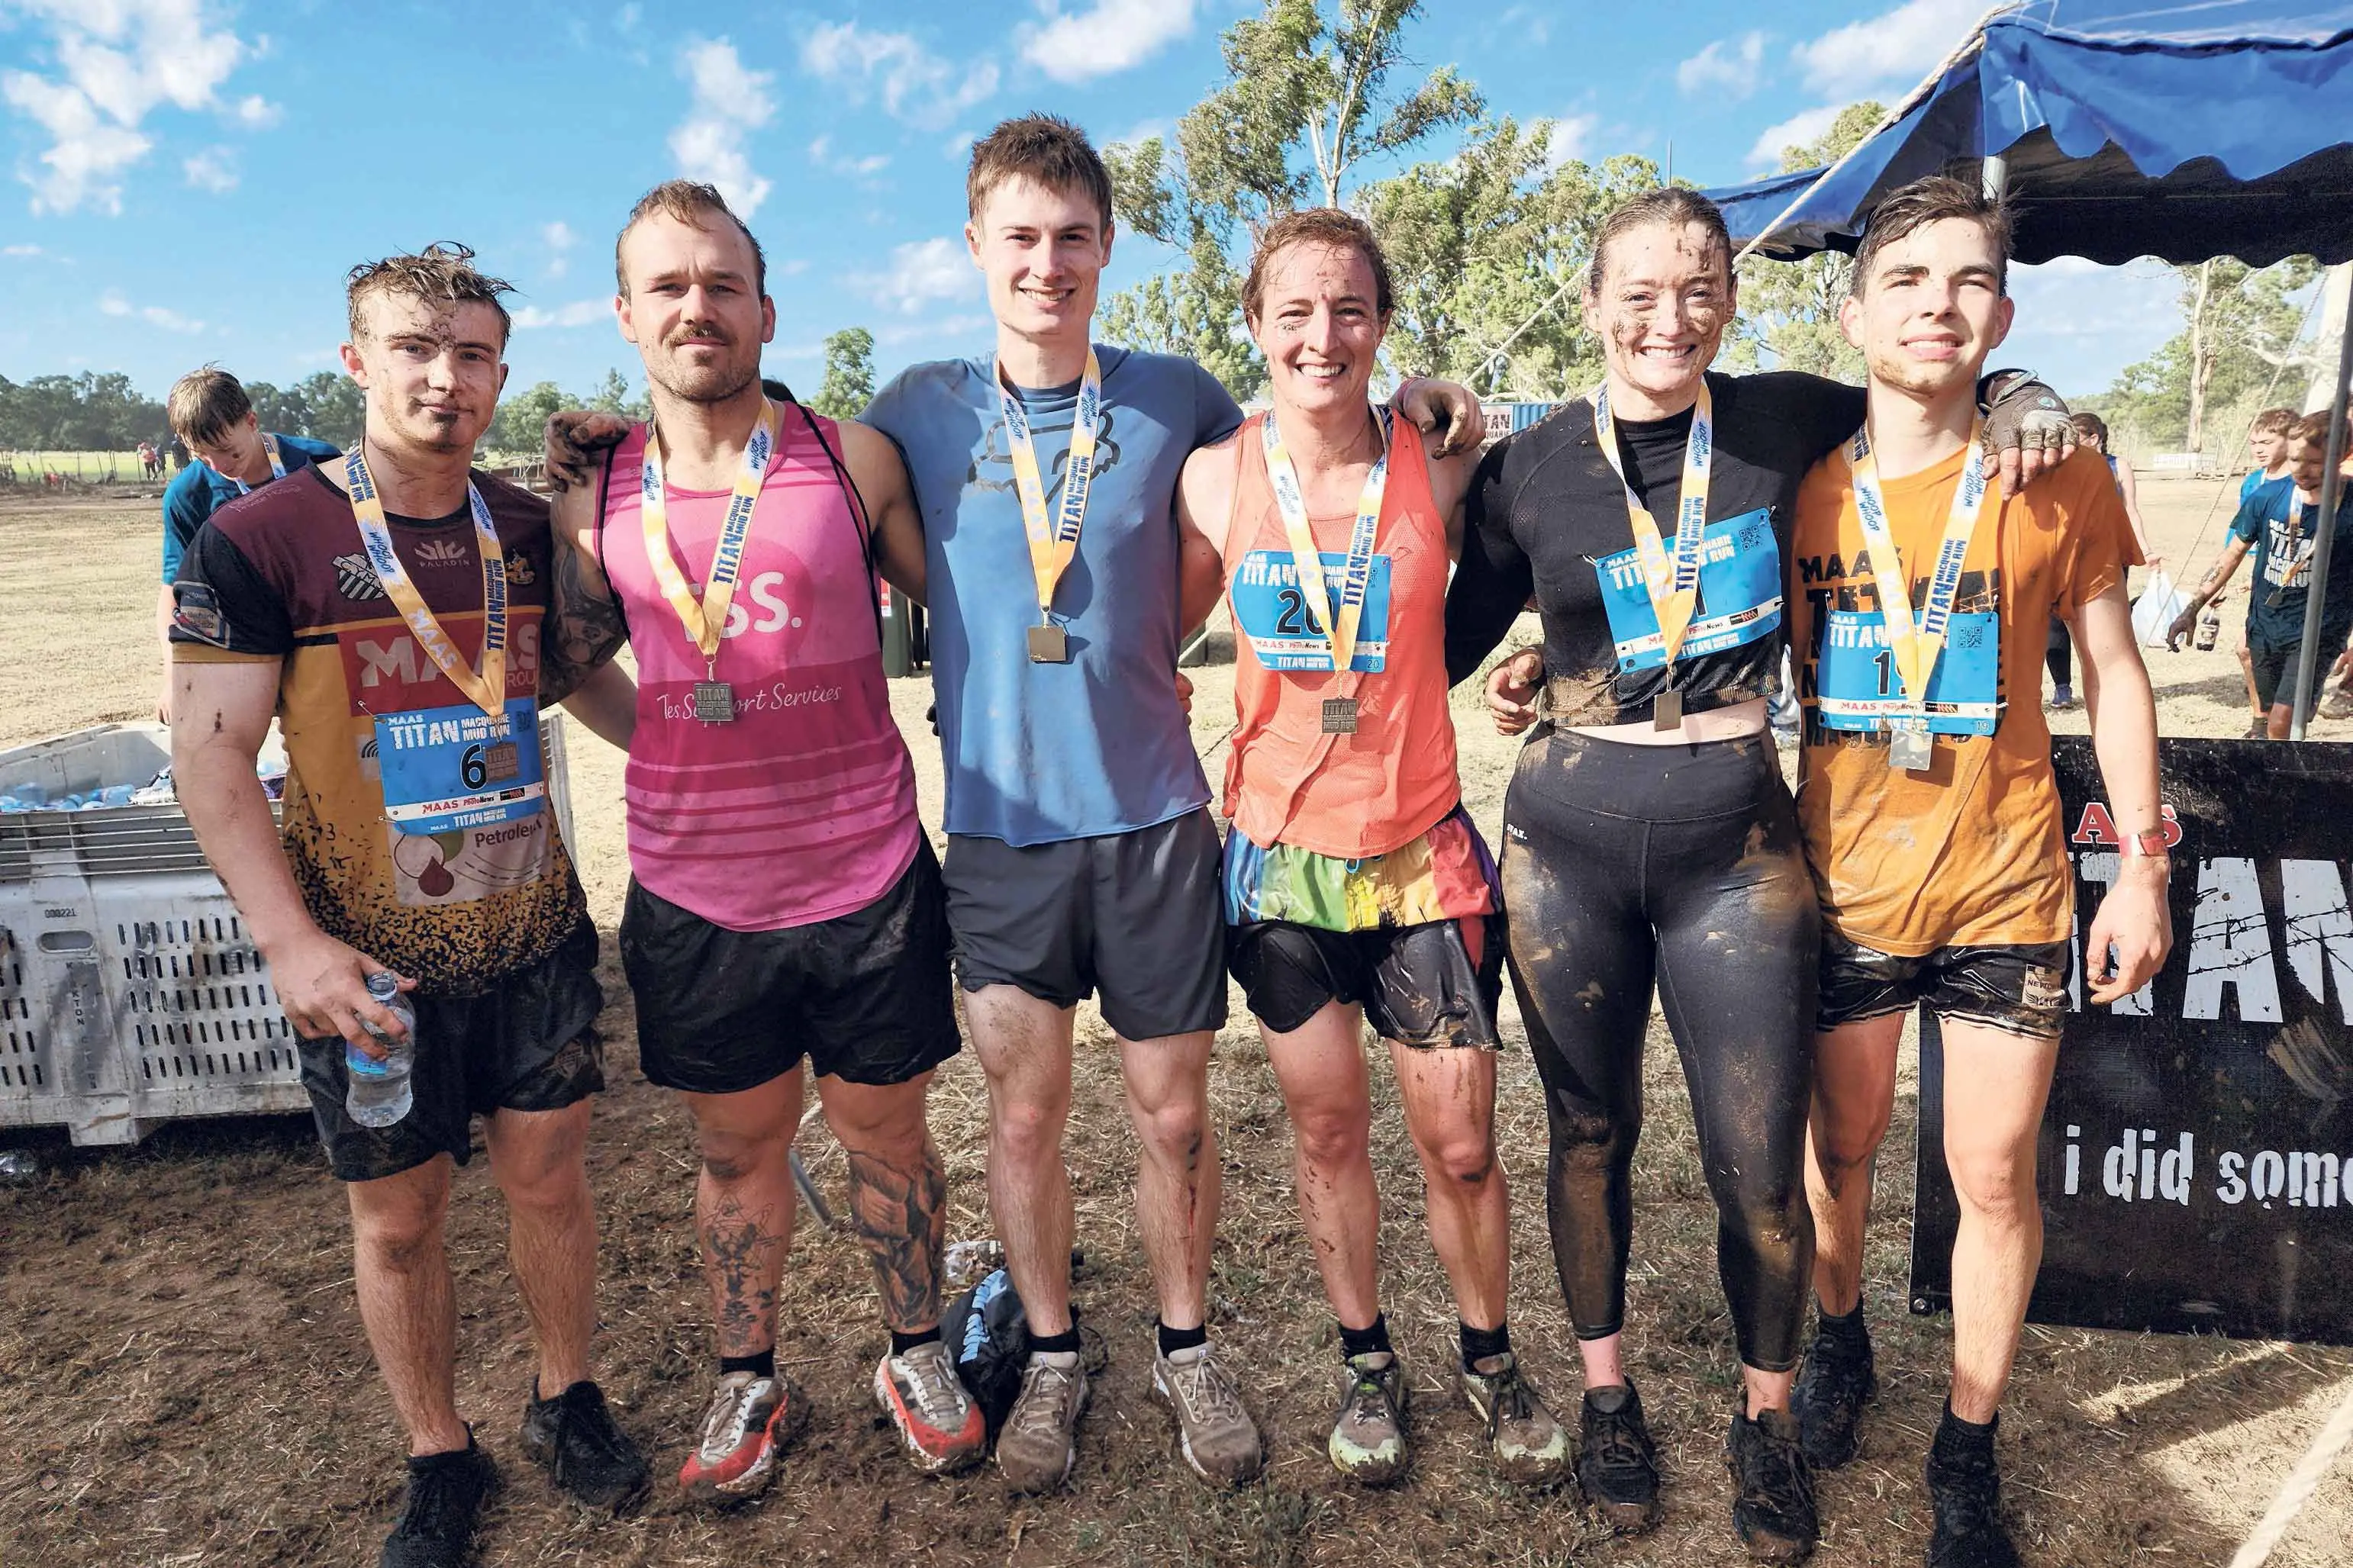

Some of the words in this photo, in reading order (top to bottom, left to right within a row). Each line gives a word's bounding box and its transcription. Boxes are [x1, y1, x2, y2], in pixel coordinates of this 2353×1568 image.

[1693, 433, 1704, 467] WHOOP
[352, 485, 366, 504] RUN
[1965, 471, 1975, 507] WHOOP
[727, 494, 744, 533] MACQUARIE
[741, 497, 755, 514] RUN
[1059, 494, 1084, 543] TITAN
[368, 545, 395, 573] WHOOP
[369, 532, 393, 559] WHOOP
[713, 533, 743, 584] TITAN
[1954, 539, 1967, 559] RUN
[1609, 562, 1646, 591] TIT
[1798, 546, 1903, 583] MAA
[1342, 554, 1368, 606] TITAN
[1925, 581, 1952, 635] TITAN
[408, 607, 457, 669] MAAS
[487, 600, 507, 650] TITAN
[1367, 659, 1379, 668] 20
[696, 688, 730, 701] TITAN
[1841, 702, 1877, 710] MAAS
[388, 714, 424, 726] MAAS
[463, 727, 488, 742] MUD
[389, 720, 460, 751] TITAN
[460, 742, 488, 791] 6
[422, 800, 459, 815] MAAS
[453, 812, 483, 828] TITAN
[2065, 1125, 2081, 1195] i
[2103, 1128, 2193, 1206] did
